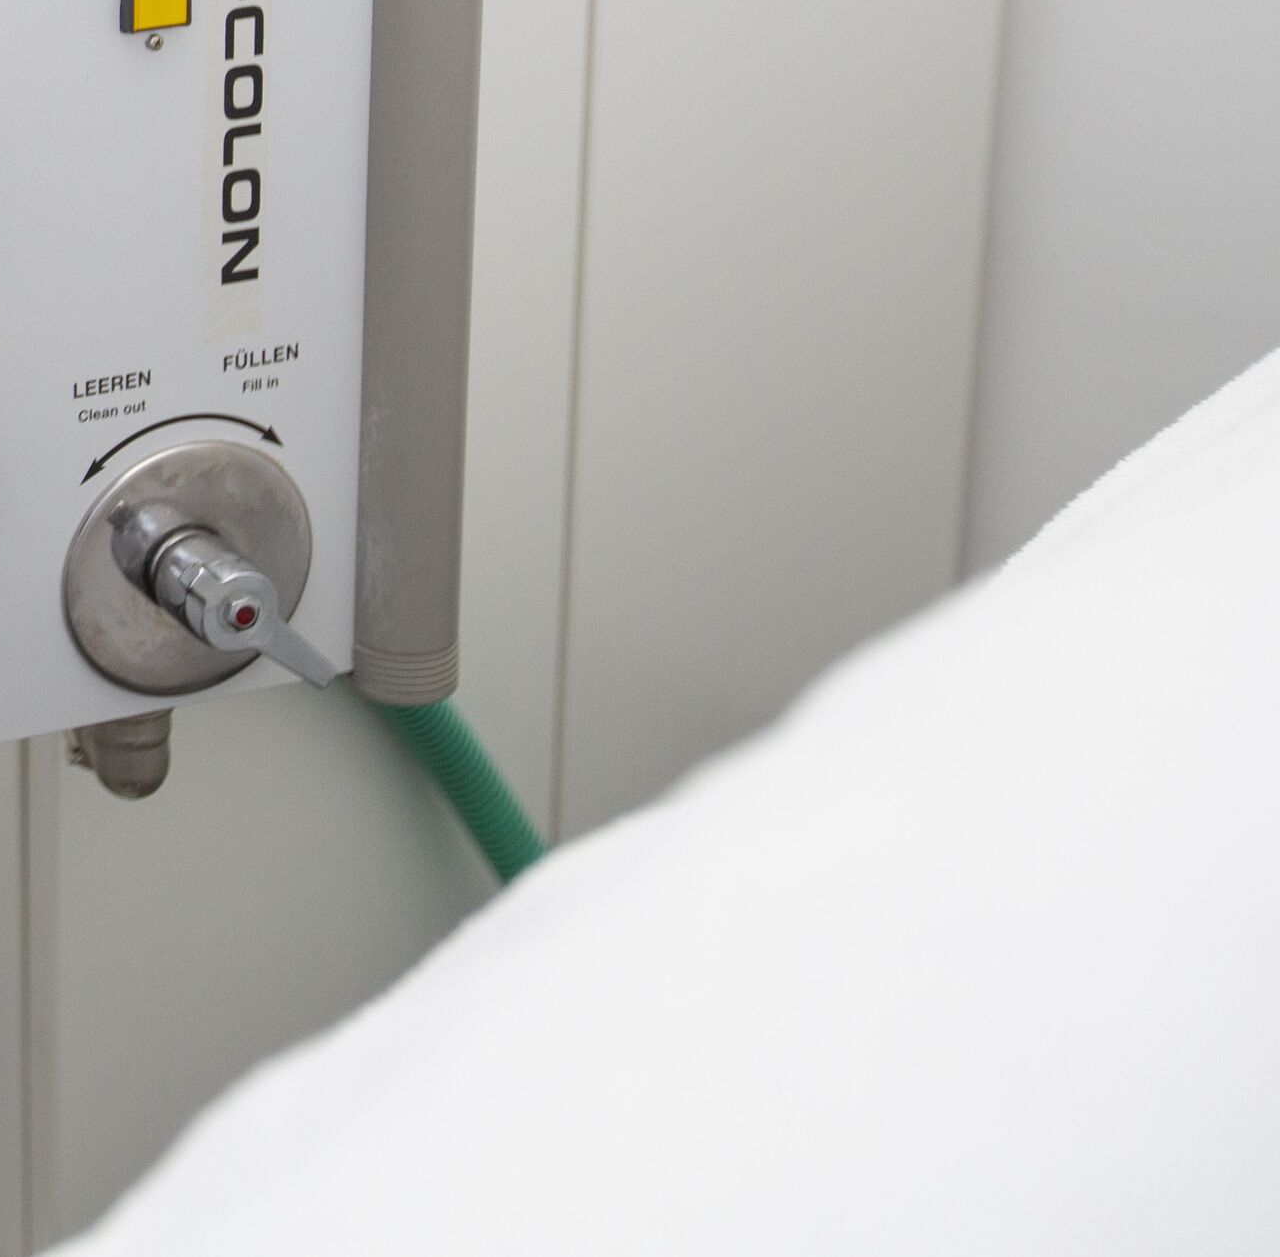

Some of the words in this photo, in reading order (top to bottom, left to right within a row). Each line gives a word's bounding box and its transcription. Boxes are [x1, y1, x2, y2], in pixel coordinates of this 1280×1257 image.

[222, 342, 300, 373] FÜLLEN
[72, 369, 152, 400] LEEREN
[241, 377, 262, 394] Fill
[266, 375, 279, 389] in
[77, 407, 119, 424] Clean
[123, 399, 147, 416] out
